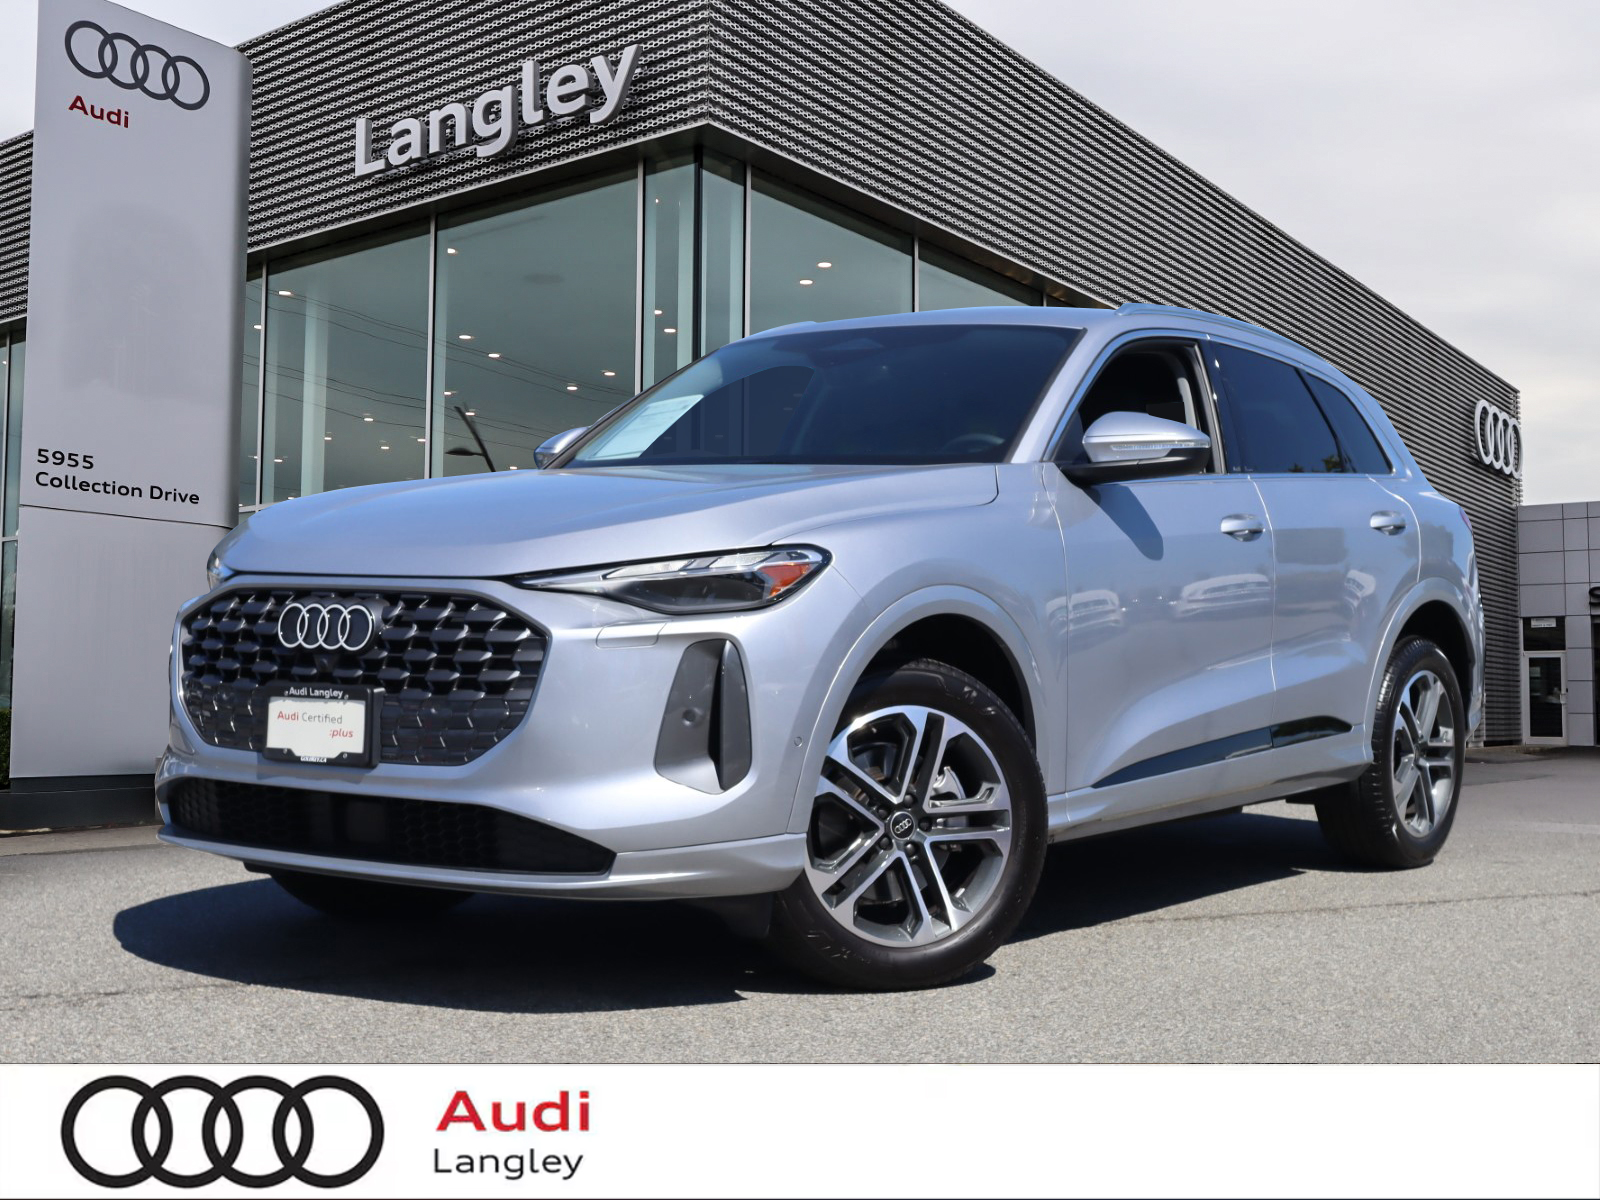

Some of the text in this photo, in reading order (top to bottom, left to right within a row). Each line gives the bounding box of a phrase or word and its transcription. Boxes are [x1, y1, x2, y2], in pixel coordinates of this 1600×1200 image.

[68, 95, 129, 129] Audi
[355, 44, 642, 177] Langley
[37, 448, 94, 469] 5955
[35, 471, 200, 504] Collection Drive
[289, 686, 343, 699] Audi Langley
[277, 710, 343, 725] Audi Certified
